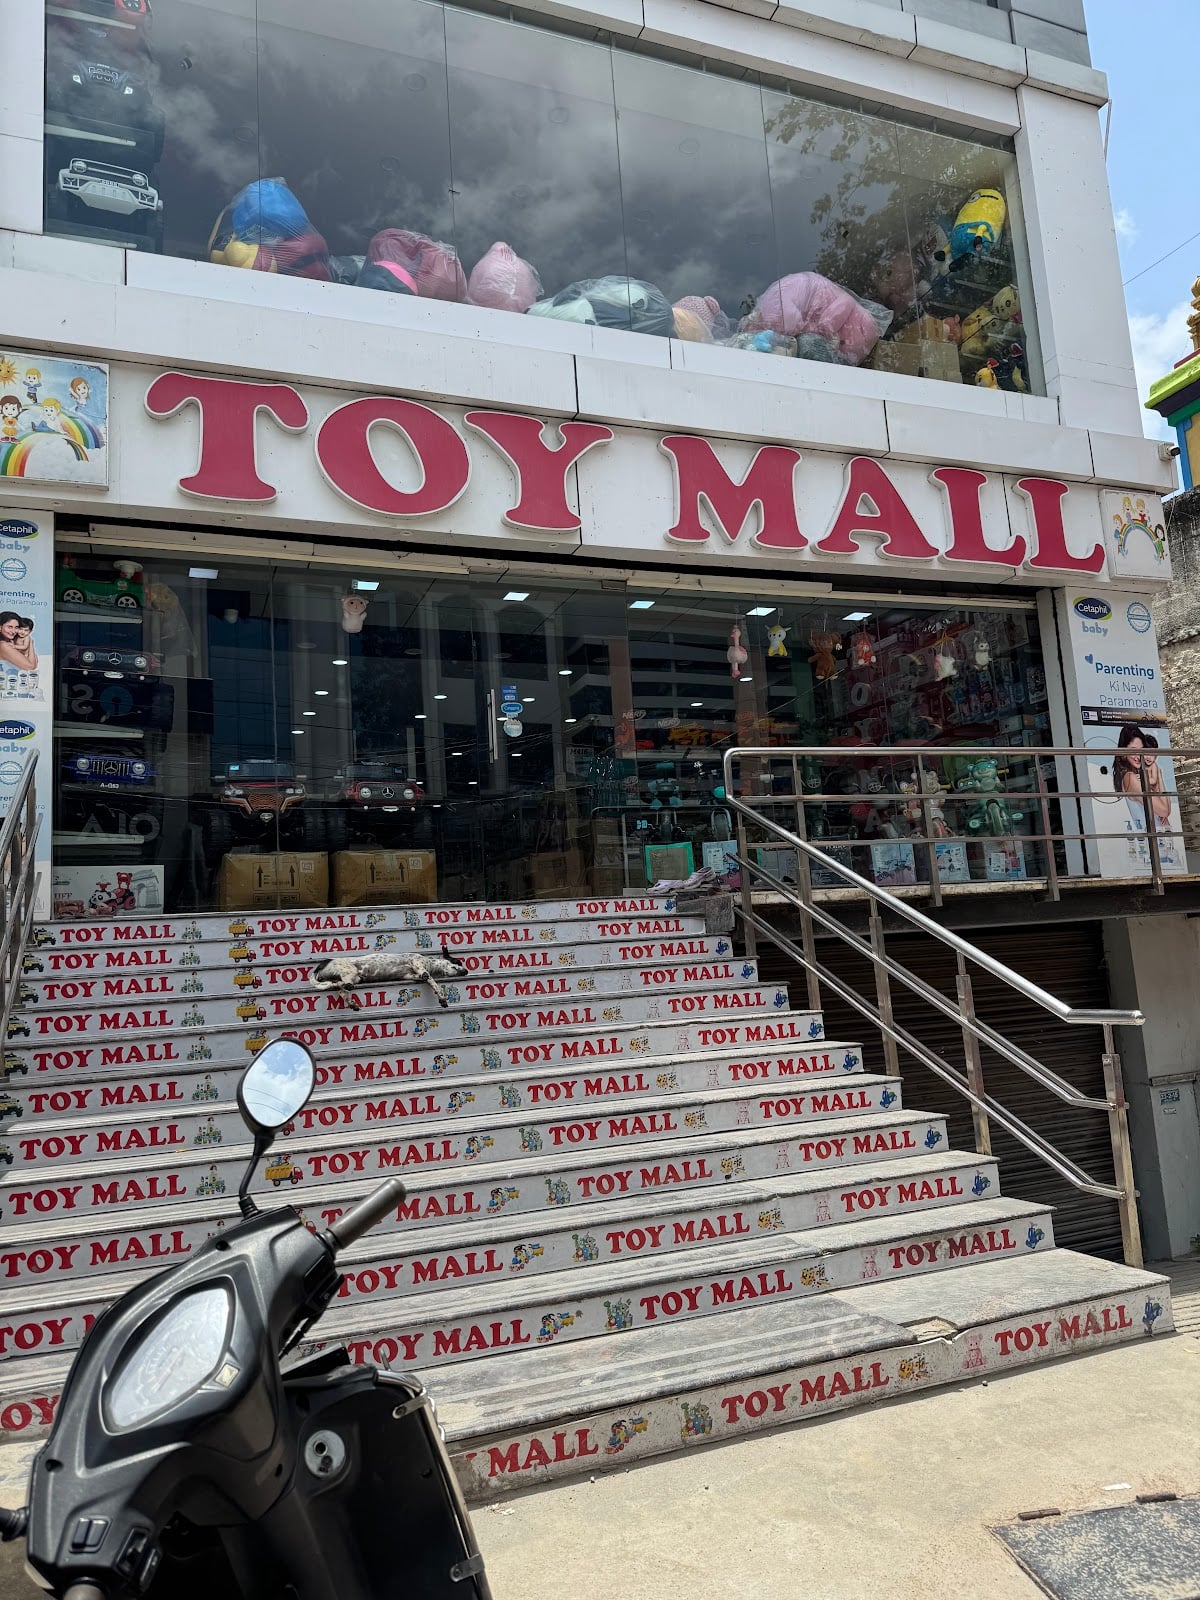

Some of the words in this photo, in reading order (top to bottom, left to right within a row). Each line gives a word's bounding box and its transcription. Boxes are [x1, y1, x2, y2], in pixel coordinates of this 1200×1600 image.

[145, 371, 614, 532] TOY
[658, 435, 1105, 575] MALL
[1077, 604, 1108, 616] Cetaphil
[1082, 621, 1108, 637] baby
[1095, 662, 1155, 680] Parenting
[1099, 694, 1158, 709] Parampara
[1109, 681, 1120, 692] Ki
[1122, 682, 1146, 696] Nayi
[0, 742, 27, 755] aby
[425, 910, 461, 924] TOY
[466, 907, 514, 922] MALL
[576, 901, 609, 915] TOY
[614, 898, 658, 912] MALL
[60, 928, 106, 943] TOY
[114, 924, 175, 940] MALL
[257, 917, 298, 934] TOY
[306, 914, 360, 930] MALL
[597, 922, 632, 936] TOY
[637, 919, 684, 934] MALL
[259, 940, 304, 958] TOY
[311, 936, 369, 954] MALL
[437, 931, 476, 947] TOY
[482, 928, 532, 944] MALL
[618, 944, 655, 960] TOY
[660, 940, 708, 957] MALL
[49, 953, 98, 970] TOY
[106, 950, 172, 967] MALL
[499, 951, 552, 968] MALL
[640, 968, 677, 985] TOY
[683, 964, 734, 982] MALL
[43, 981, 96, 1000] TOY
[104, 976, 174, 996] MALL
[465, 982, 508, 1000] TOY
[514, 978, 571, 995] MALL
[270, 995, 319, 1015] TOY
[667, 995, 707, 1014] TOY
[712, 992, 766, 1008] MALL
[35, 1014, 91, 1034] TOY
[100, 1009, 173, 1031] MALL
[340, 1021, 408, 1042] MALL
[485, 1011, 531, 1030] TOY
[537, 1008, 596, 1027] MALL
[697, 1027, 739, 1046] TOY
[744, 1022, 801, 1043] MALL
[33, 1049, 93, 1072] TOY
[101, 1042, 179, 1066] MALL
[507, 1043, 555, 1064] TOY
[560, 1037, 623, 1058] MALL
[315, 1064, 346, 1086] OY
[354, 1057, 426, 1082] MALL
[727, 1060, 772, 1081] TOY
[777, 1053, 835, 1077] MALL
[28, 1089, 89, 1114] TOY
[101, 1081, 183, 1107] MALL
[527, 1080, 577, 1103] TOY
[583, 1073, 650, 1096] MALL
[298, 1103, 357, 1129] TOY
[365, 1095, 441, 1120] MALL
[759, 1097, 806, 1119] TOY
[810, 1090, 873, 1114] MALL
[548, 1121, 601, 1146] TOY
[608, 1112, 678, 1138] MALL
[19, 1134, 88, 1161] TOY
[97, 1124, 185, 1152] MALL
[799, 1138, 846, 1162] TOY
[853, 1130, 917, 1155] MALL
[307, 1149, 370, 1177] TOY
[377, 1139, 459, 1168] MALL
[577, 1170, 632, 1197] TOY
[640, 1159, 712, 1188] MALL
[8, 1186, 82, 1215] TOY
[91, 1174, 187, 1206] MALL
[840, 1186, 890, 1213] TOY
[897, 1176, 963, 1204] MALL
[605, 1225, 666, 1254] TOY
[672, 1212, 750, 1244] MALL
[1, 1245, 80, 1278] TOY
[90, 1231, 192, 1266] MALL
[888, 1242, 939, 1269] TOY
[949, 1229, 1017, 1258] MALL
[412, 1249, 504, 1285] MALL
[640, 1286, 702, 1321] TOY
[711, 1269, 793, 1306] MALL
[433, 1319, 531, 1356] MALL
[993, 1321, 1051, 1356] TOY
[1059, 1305, 1133, 1342] MALL
[721, 1383, 792, 1424] TOY
[800, 1362, 890, 1407] MALL
[487, 1428, 600, 1478] MALL
